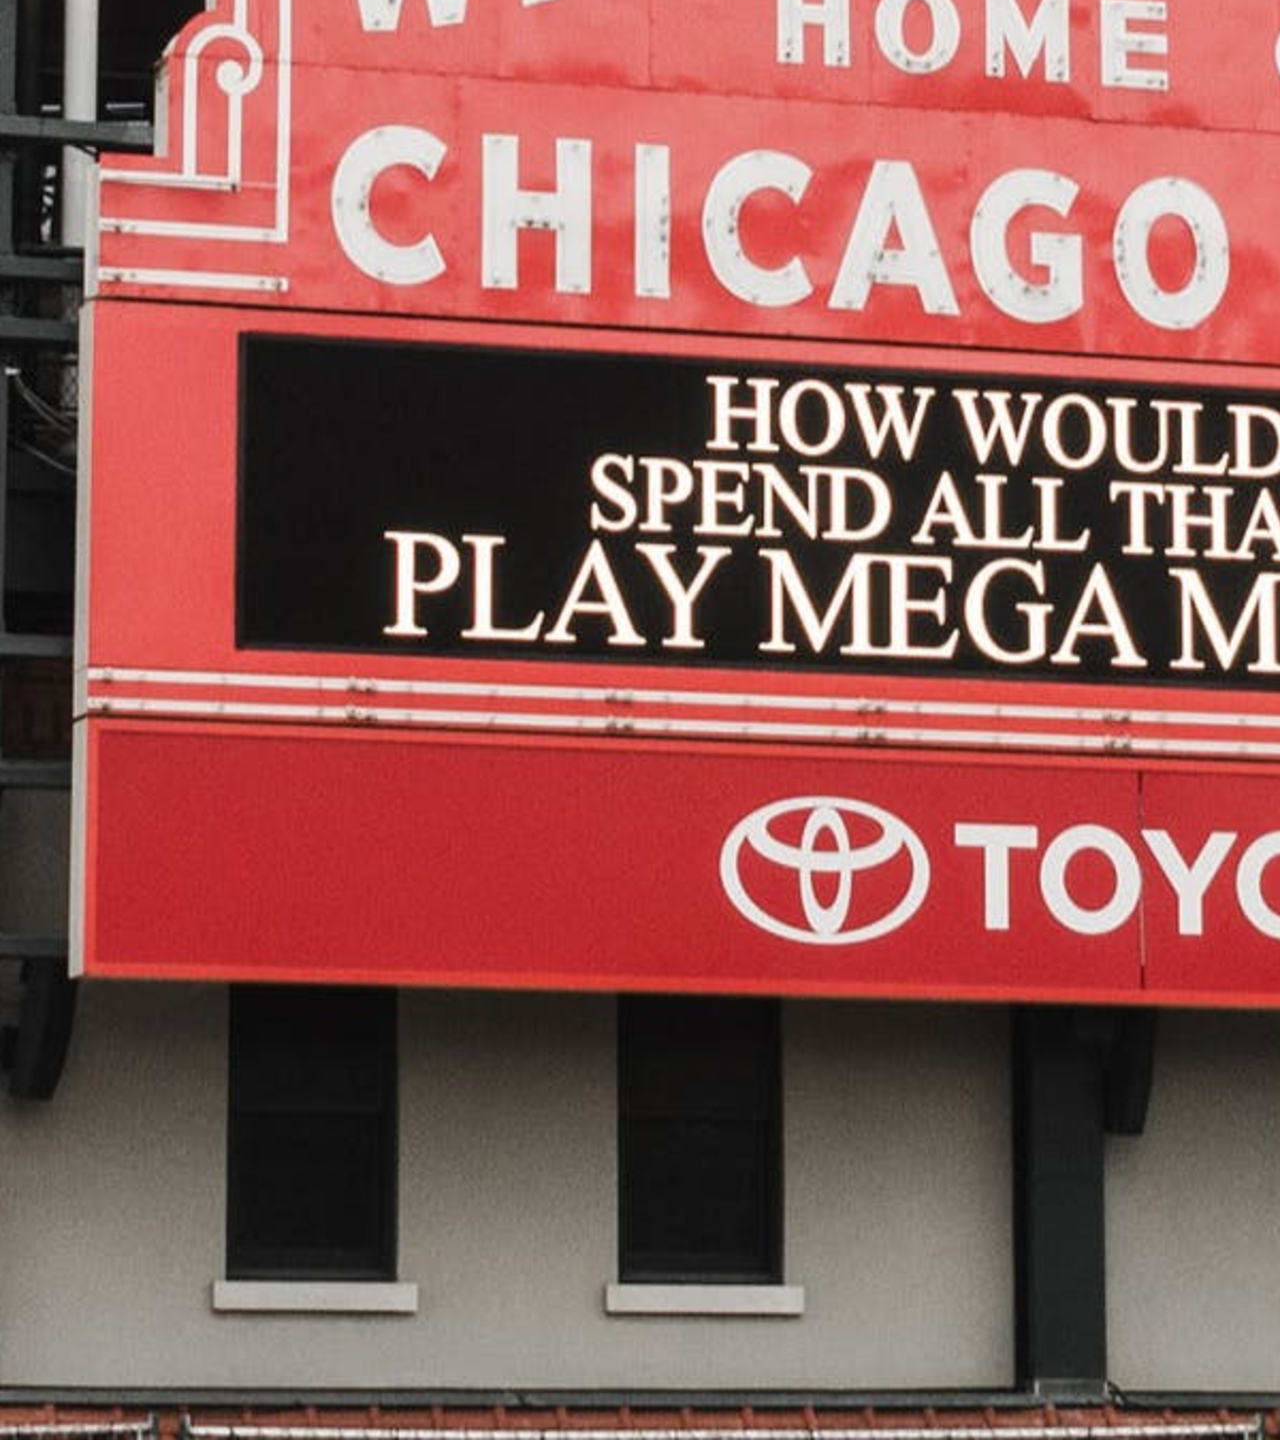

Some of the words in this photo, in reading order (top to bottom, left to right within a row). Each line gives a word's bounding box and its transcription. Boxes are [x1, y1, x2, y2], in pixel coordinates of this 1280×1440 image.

[330, 123, 1231, 331] CHICAGO
[706, 374, 936, 461] HOW
[587, 453, 892, 542] SPEND
[911, 470, 1092, 552] ALL
[383, 530, 733, 649] PLAY
[757, 548, 1148, 667] MEGA
